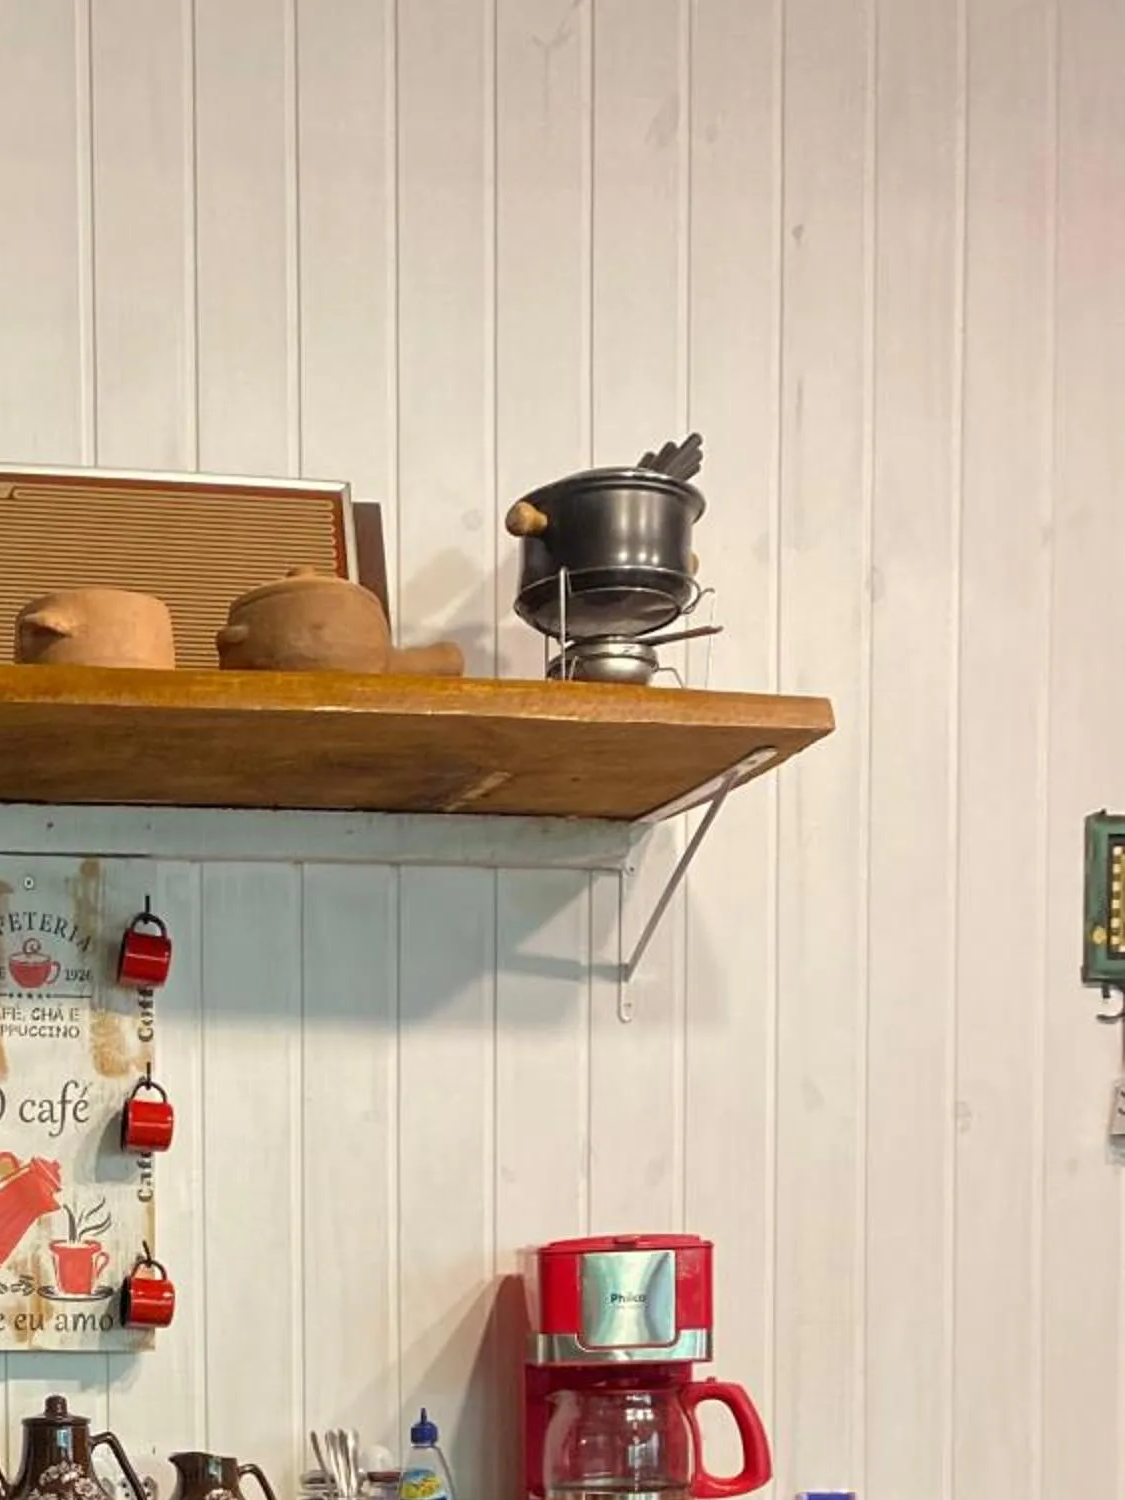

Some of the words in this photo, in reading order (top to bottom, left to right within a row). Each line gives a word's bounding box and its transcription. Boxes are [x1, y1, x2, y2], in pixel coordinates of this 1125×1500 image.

[18, 1080, 90, 1137] café
[13, 1313, 44, 1332] eu
[54, 1312, 114, 1333] amo
